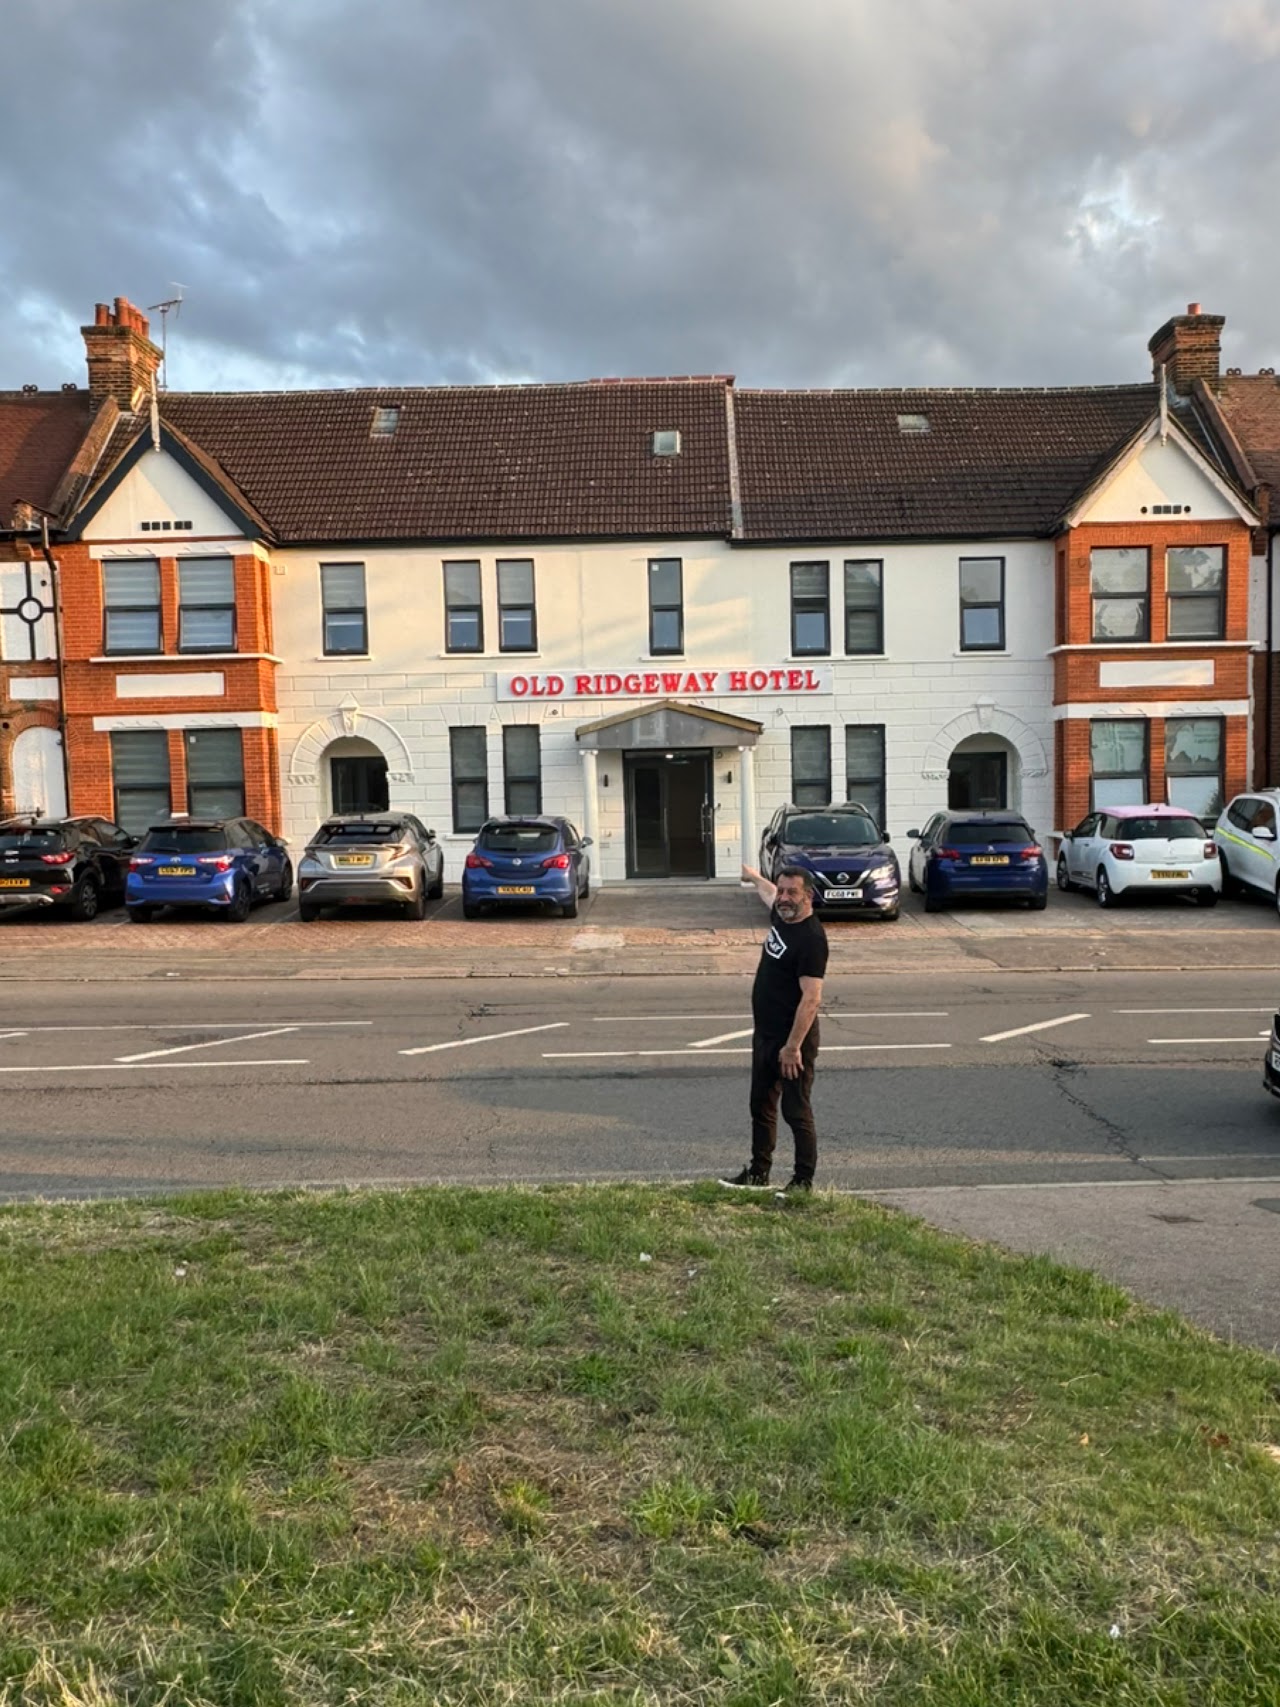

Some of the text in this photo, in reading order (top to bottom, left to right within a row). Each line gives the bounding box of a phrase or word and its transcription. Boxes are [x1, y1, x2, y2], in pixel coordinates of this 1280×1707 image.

[510, 669, 820, 697] OLD RIDGEWAY HOTEL
